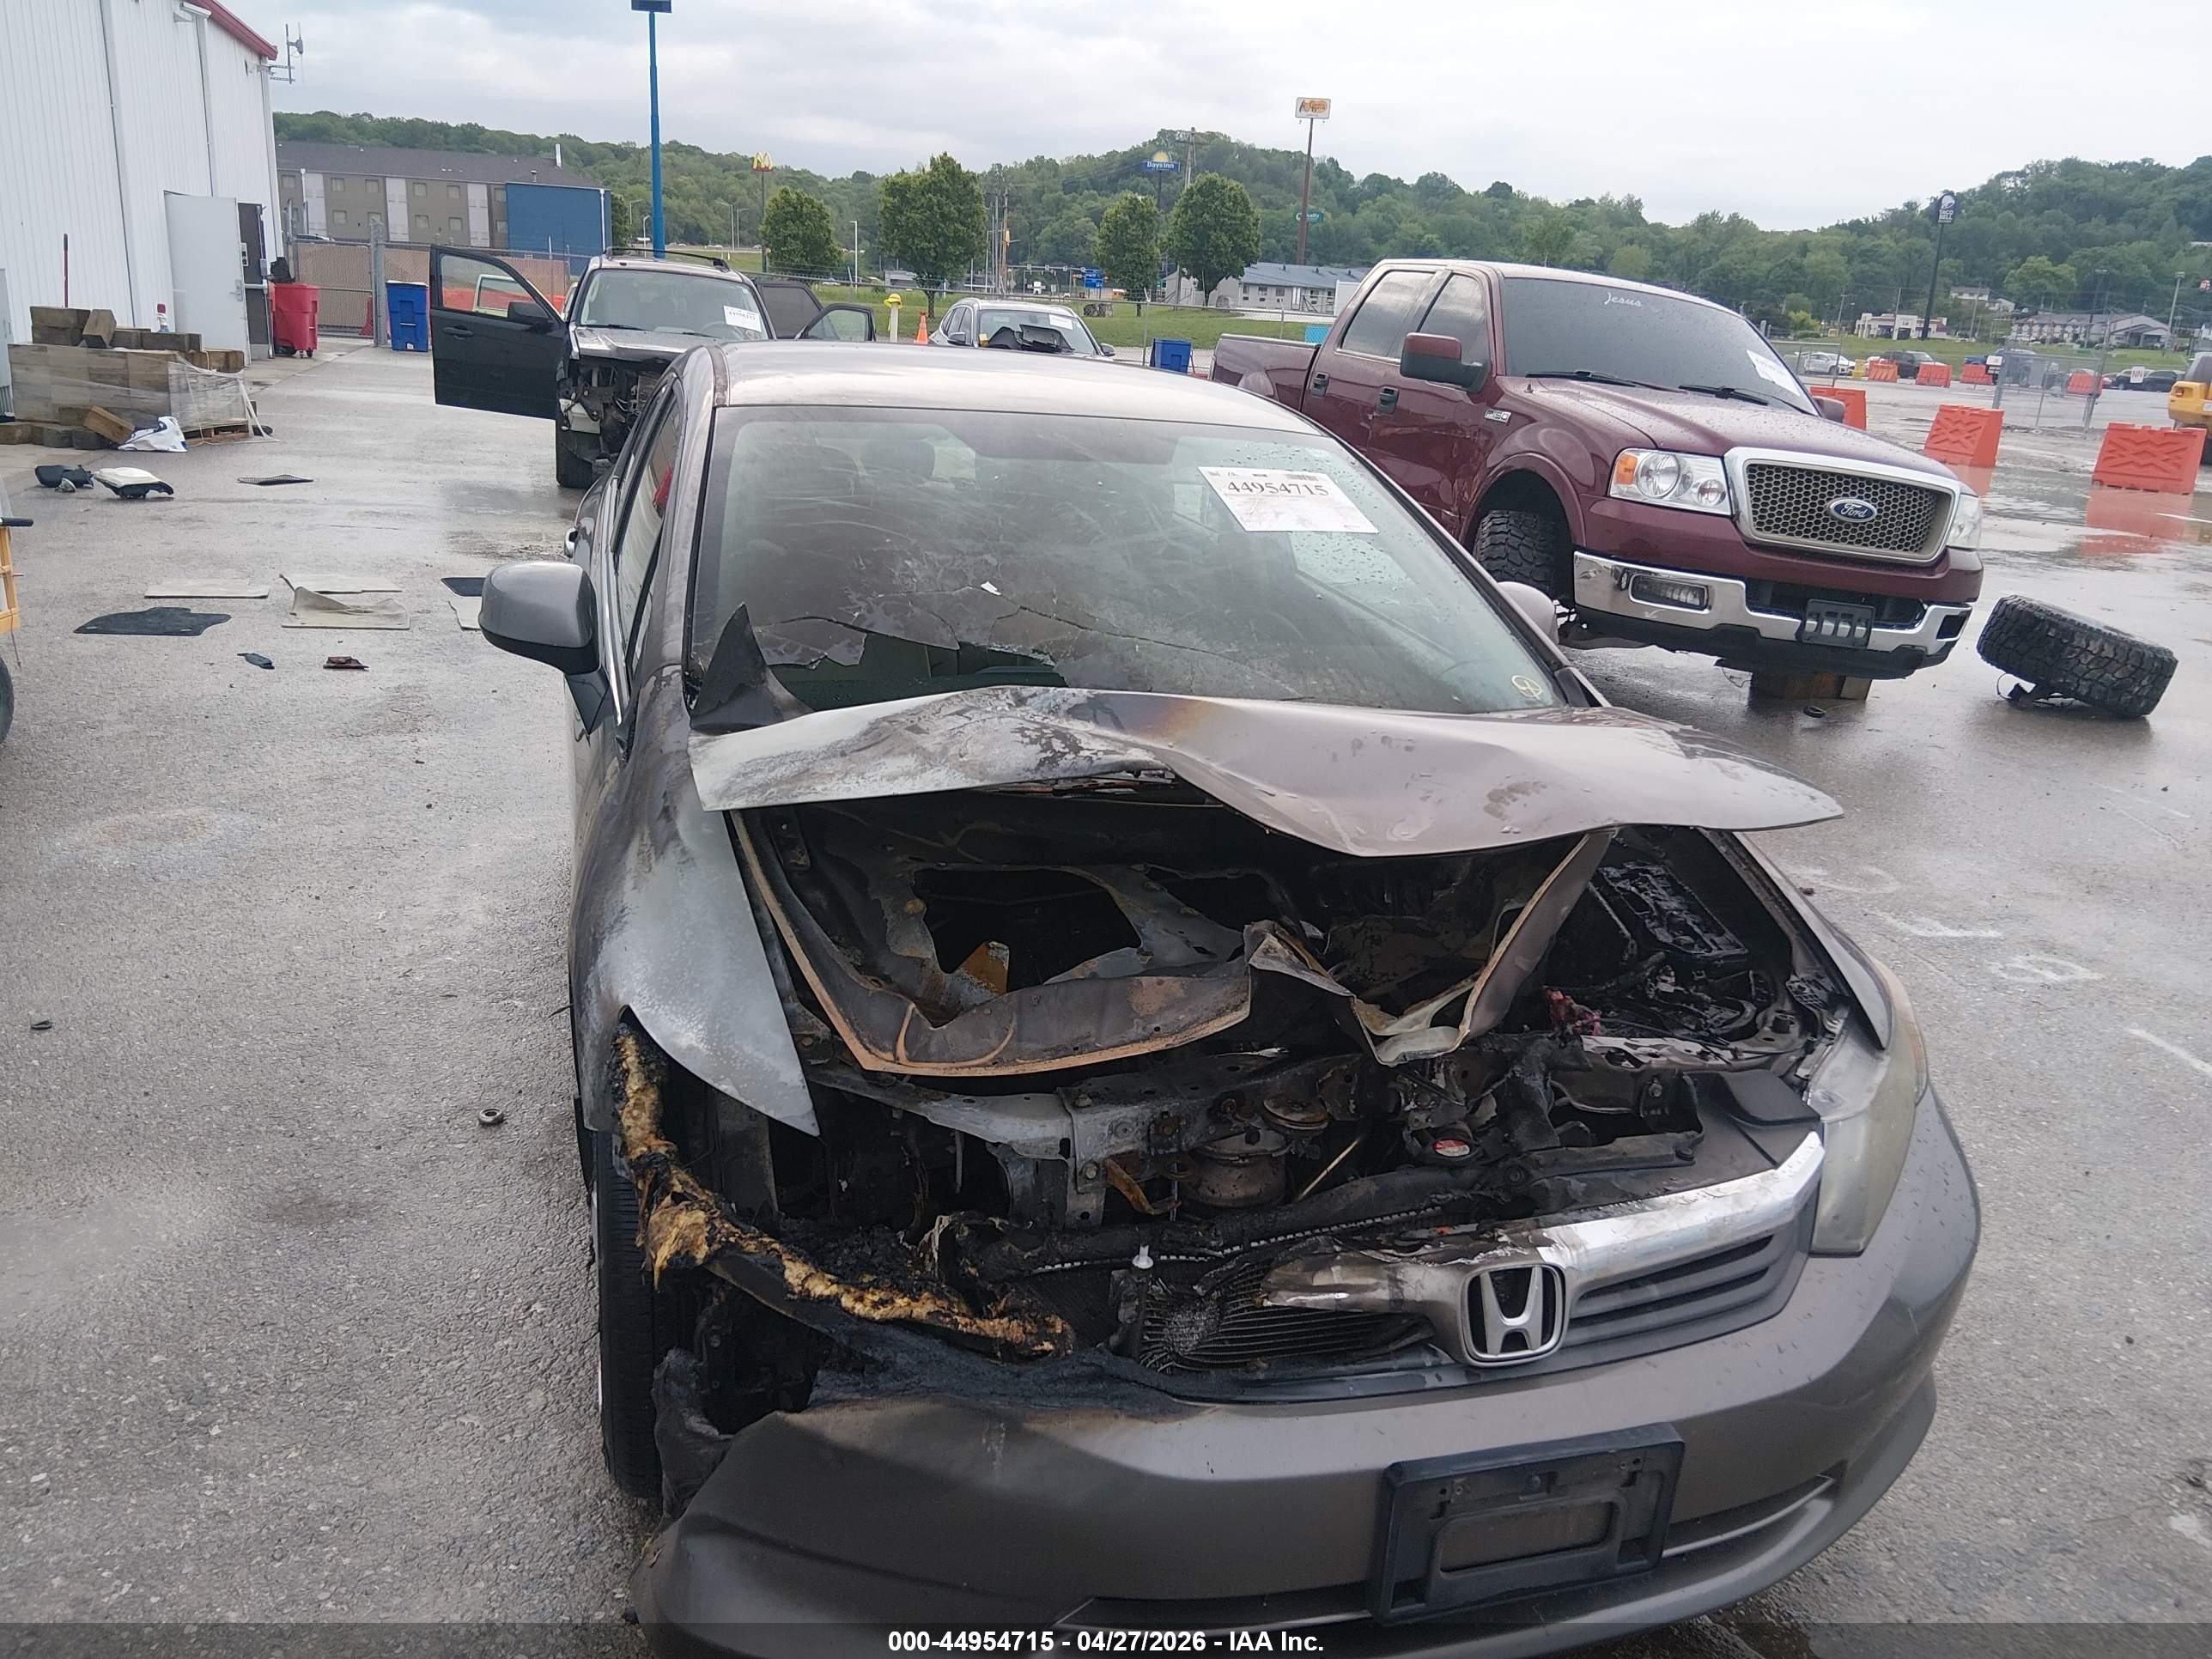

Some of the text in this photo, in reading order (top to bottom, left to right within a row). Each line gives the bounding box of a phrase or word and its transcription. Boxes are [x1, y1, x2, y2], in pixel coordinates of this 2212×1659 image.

[1146, 161, 1175, 171] Days Inn
[1603, 291, 1644, 307] Jesus
[1227, 480, 1330, 497] 44954715
[1840, 501, 1869, 518] Ford
